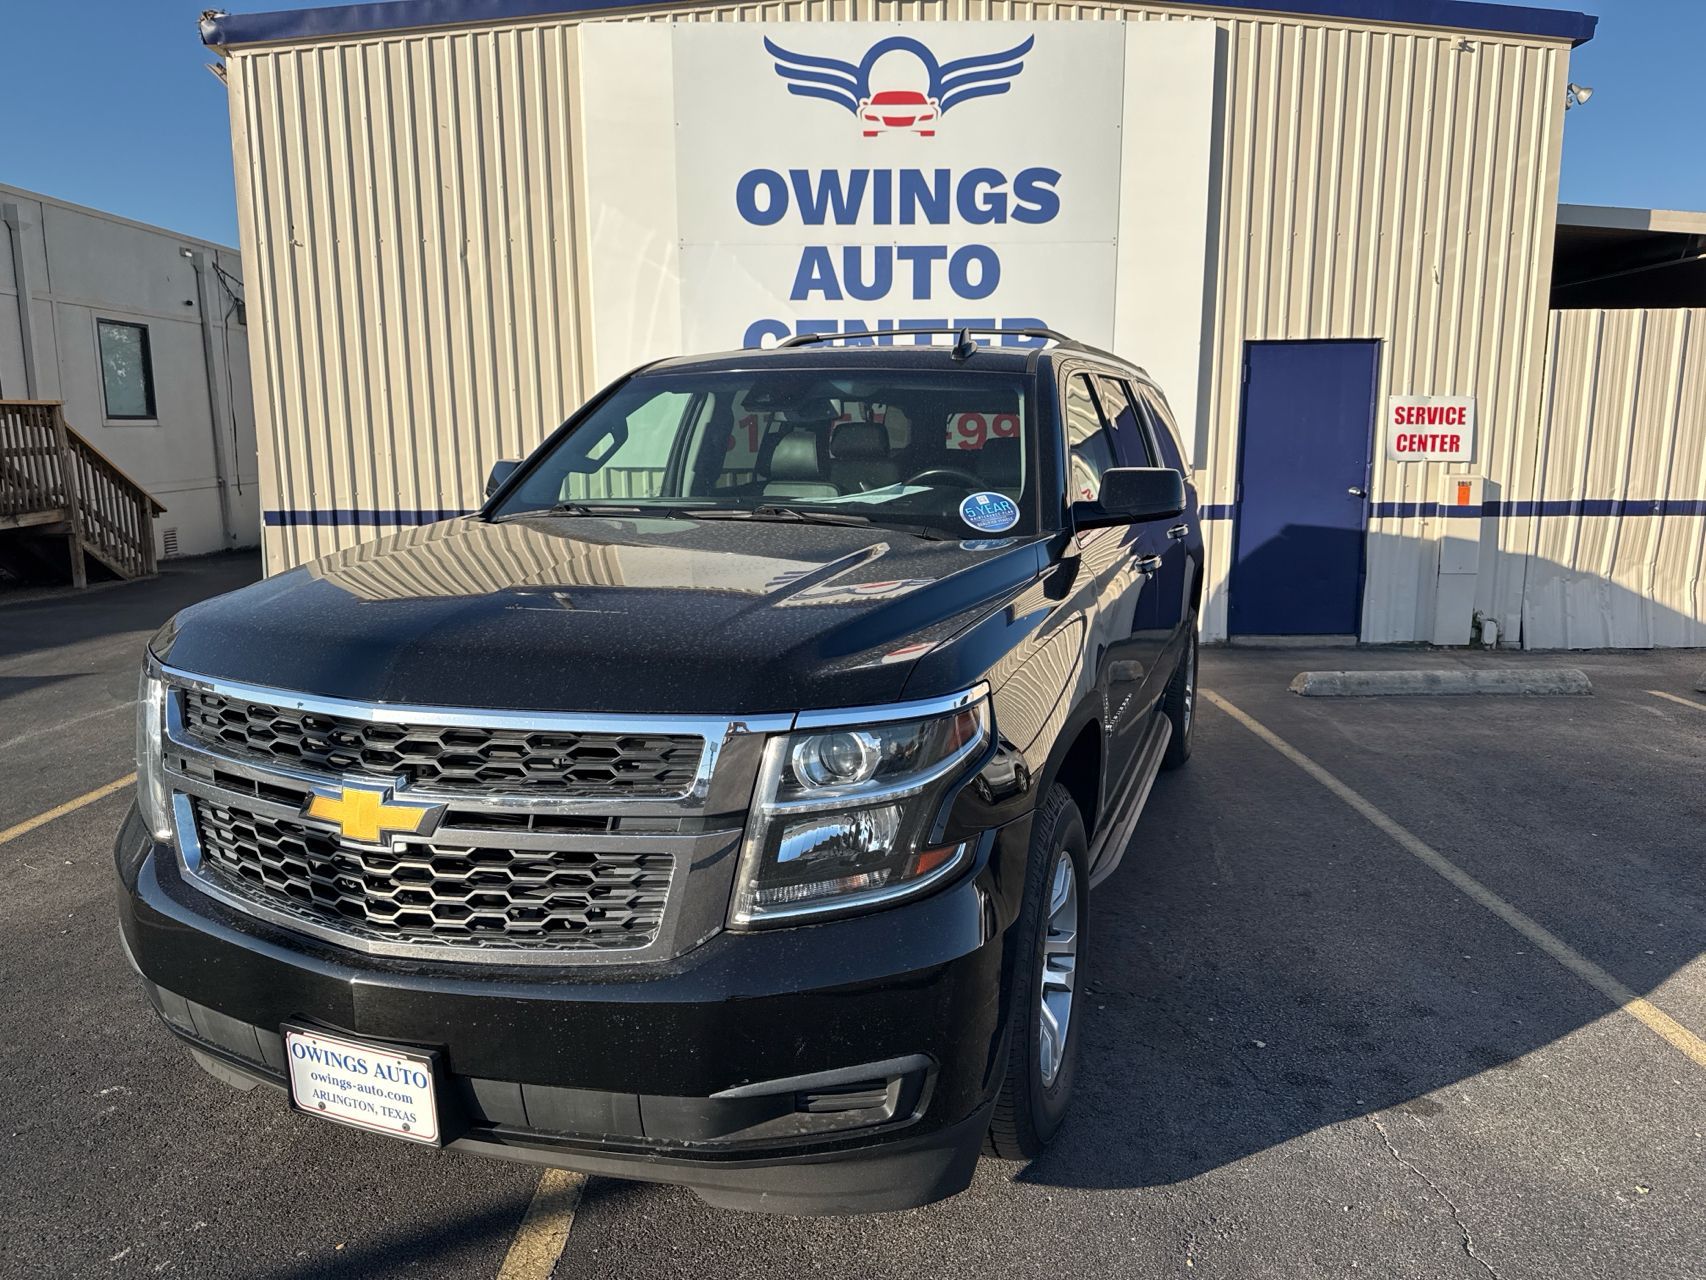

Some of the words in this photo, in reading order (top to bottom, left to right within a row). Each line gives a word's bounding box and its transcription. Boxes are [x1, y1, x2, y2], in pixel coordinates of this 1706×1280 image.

[736, 167, 1062, 226] OWINGS
[789, 243, 1001, 301] AUTO
[1394, 406, 1467, 425] SERVICE
[1396, 434, 1461, 453] CENTER
[965, 507, 976, 518] 5
[976, 500, 1011, 516] YEAR
[292, 1042, 369, 1075] OWINGS
[374, 1062, 428, 1089] AUTO
[311, 1071, 413, 1105] owings-auto.com
[312, 1088, 378, 1116] ARLINGTON,
[380, 1105, 417, 1123] TEXAS
